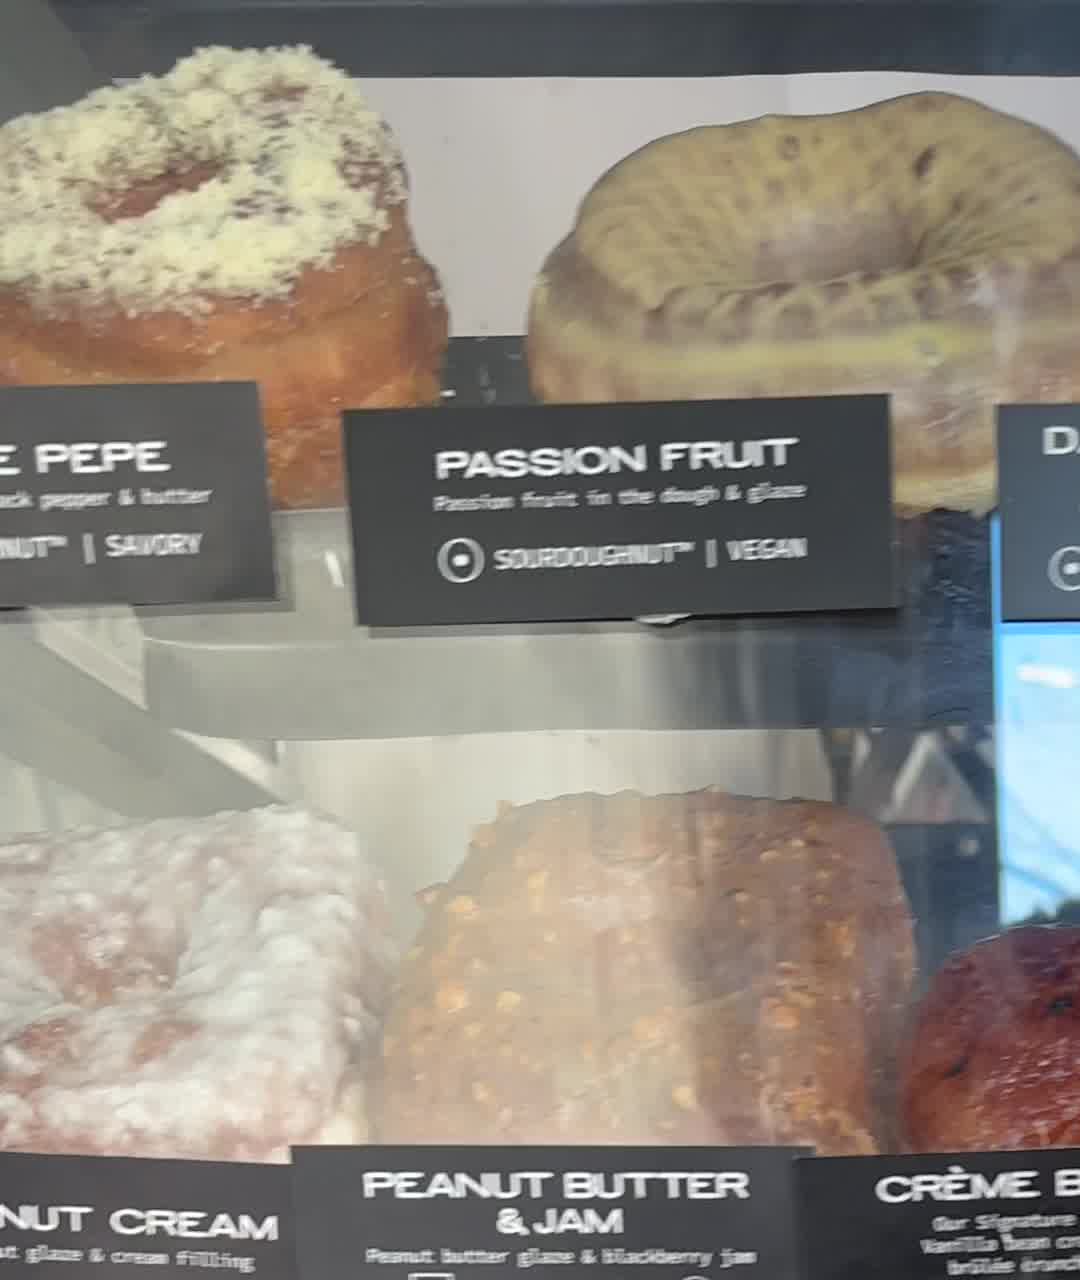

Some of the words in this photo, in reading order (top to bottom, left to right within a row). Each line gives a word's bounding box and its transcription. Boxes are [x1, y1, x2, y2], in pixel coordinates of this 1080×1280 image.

[34, 441, 172, 473] PEPE
[434, 444, 647, 480] PASSION
[660, 437, 800, 471] FRUIT
[618, 488, 655, 505] the
[105, 532, 203, 557] SAVORY
[726, 537, 808, 561] VEGAN
[362, 1171, 555, 1199] PEANUT
[563, 1171, 750, 1199] BUTTER
[874, 1165, 1042, 1203] CRÈME
[109, 1208, 279, 1240] CREAM
[495, 1208, 530, 1235] &
[533, 1208, 625, 1234] JAM
[365, 1248, 436, 1263] Peanut
[441, 1249, 511, 1263] butter
[517, 1248, 575, 1268] glaze
[580, 1249, 597, 1264] &
